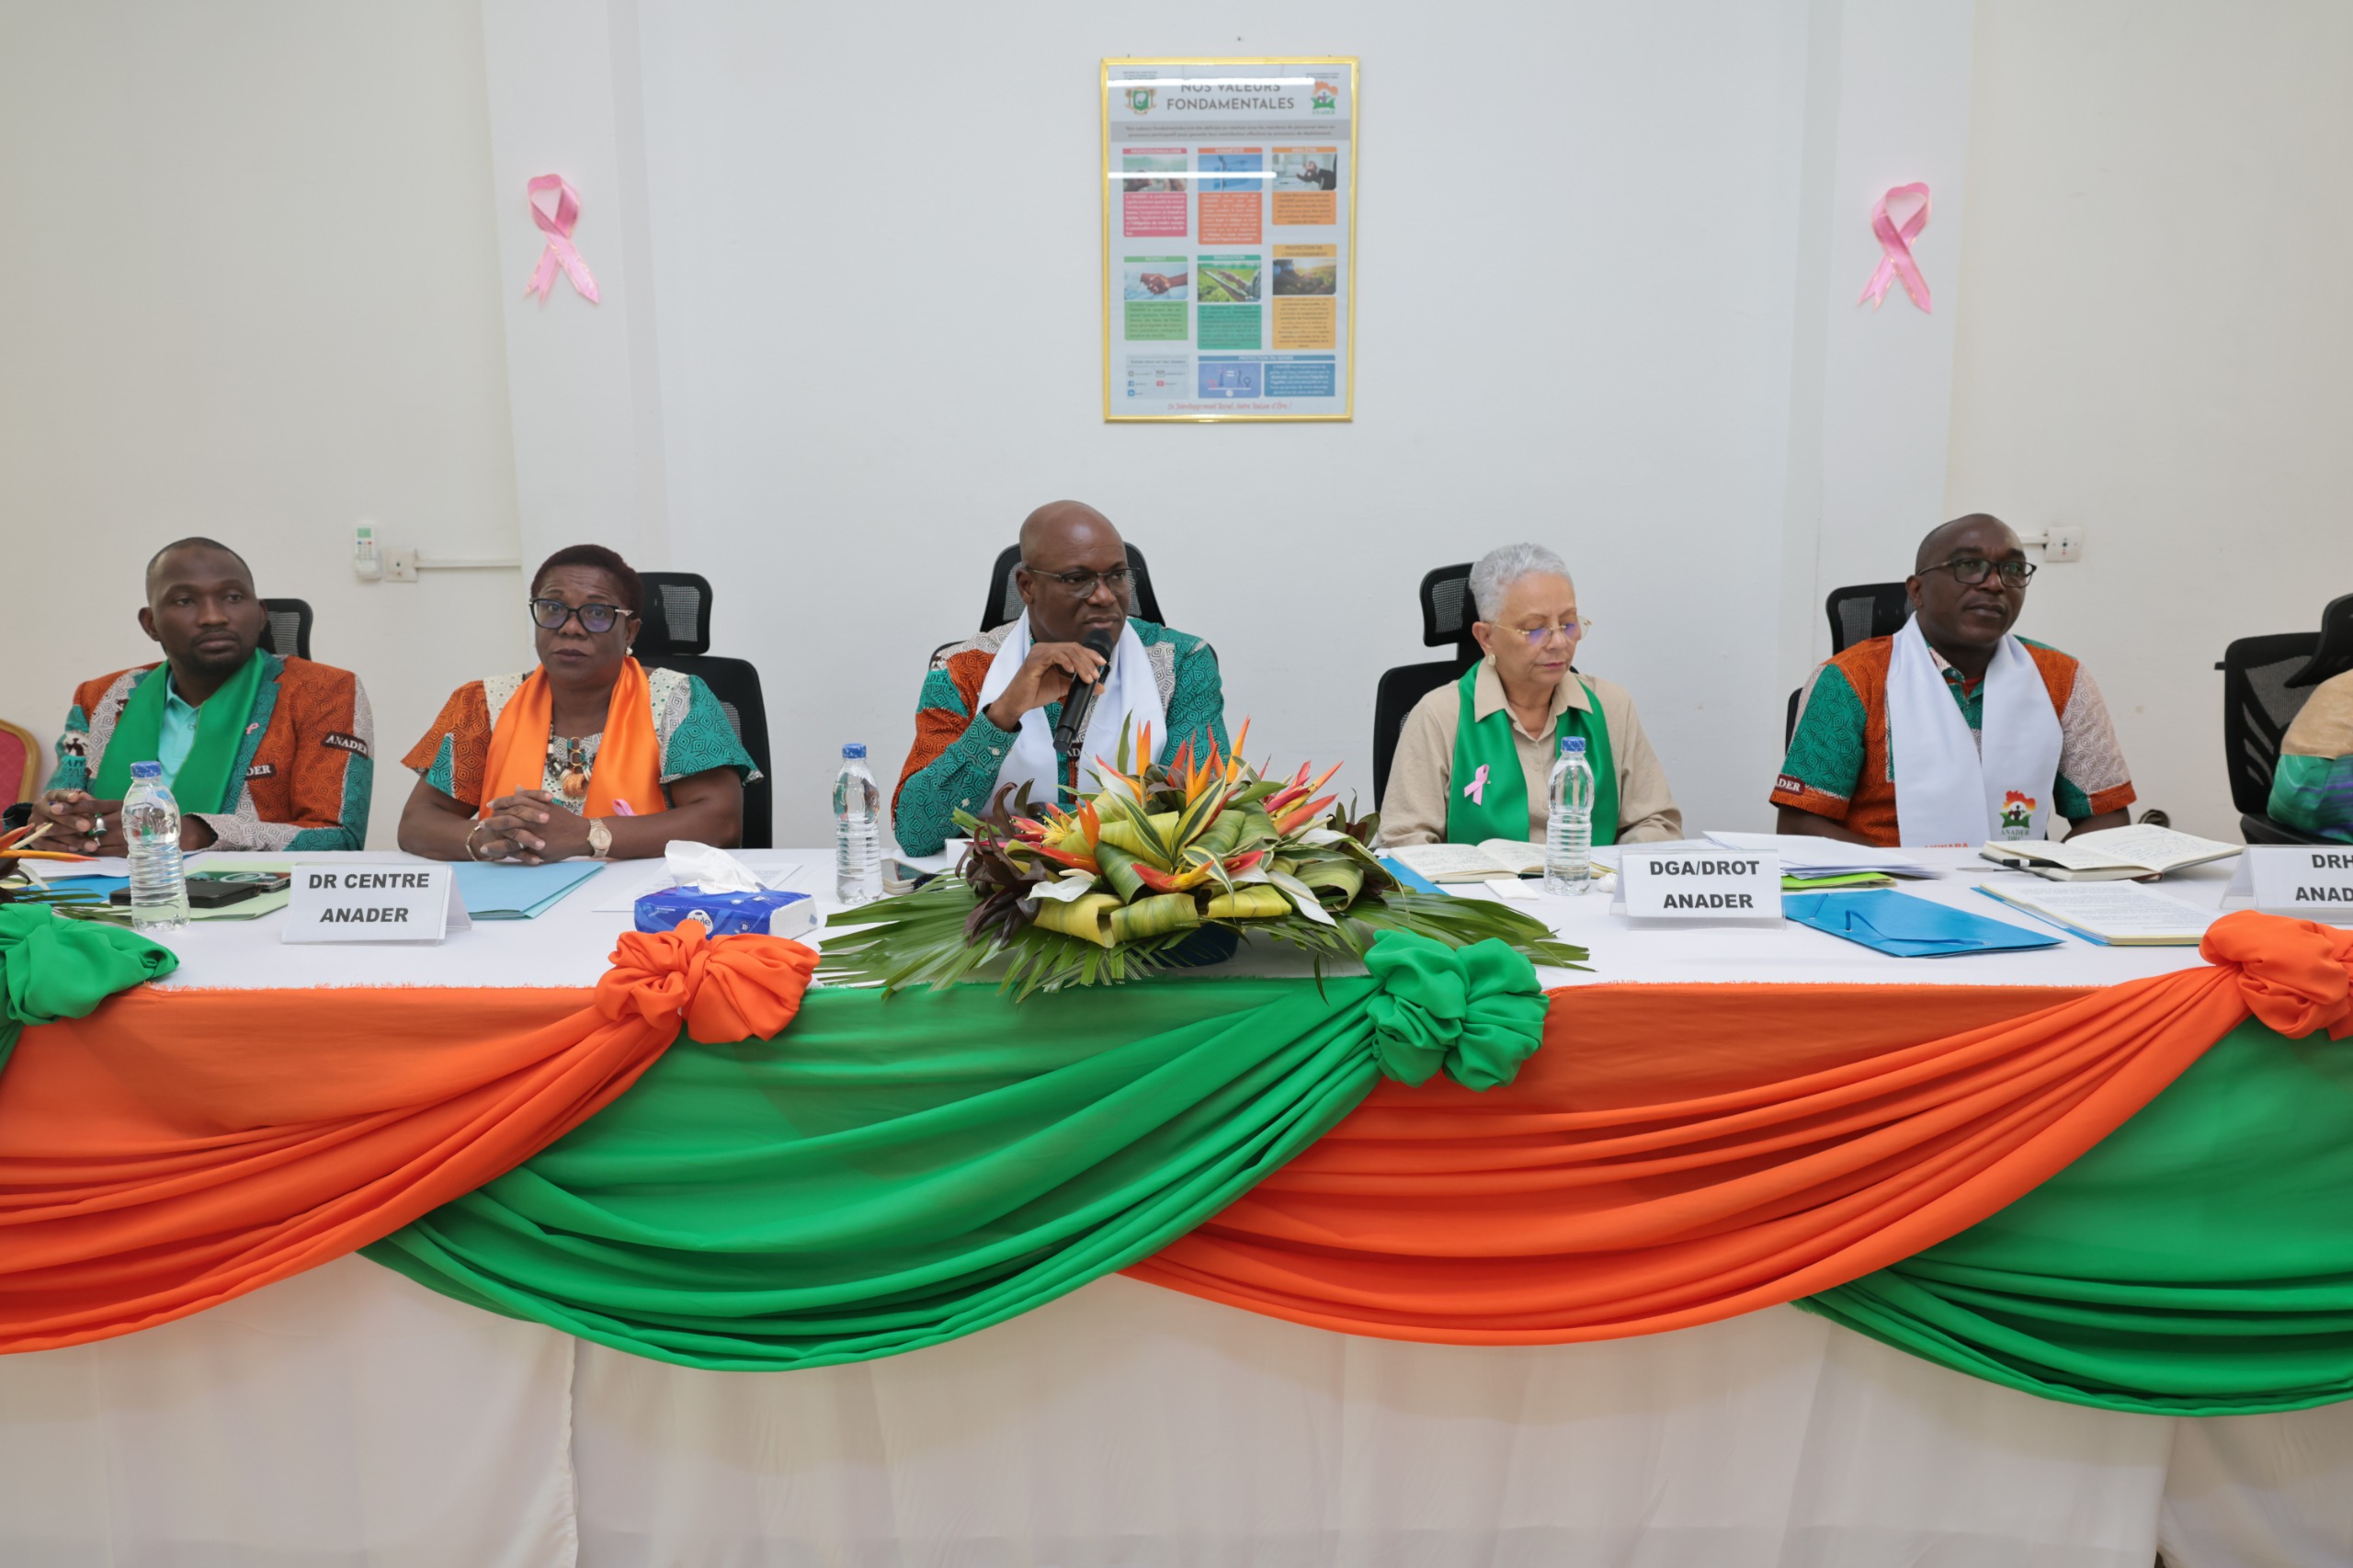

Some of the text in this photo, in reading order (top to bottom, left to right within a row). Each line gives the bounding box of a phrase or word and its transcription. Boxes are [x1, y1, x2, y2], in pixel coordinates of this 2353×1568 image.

[1166, 97, 1294, 110] FONDAMENTALES
[1650, 860, 1760, 875] DGA/DROT
[309, 873, 430, 889] DR CENTRE
[1663, 893, 1754, 909] ANADER
[319, 907, 409, 923] ANADER
